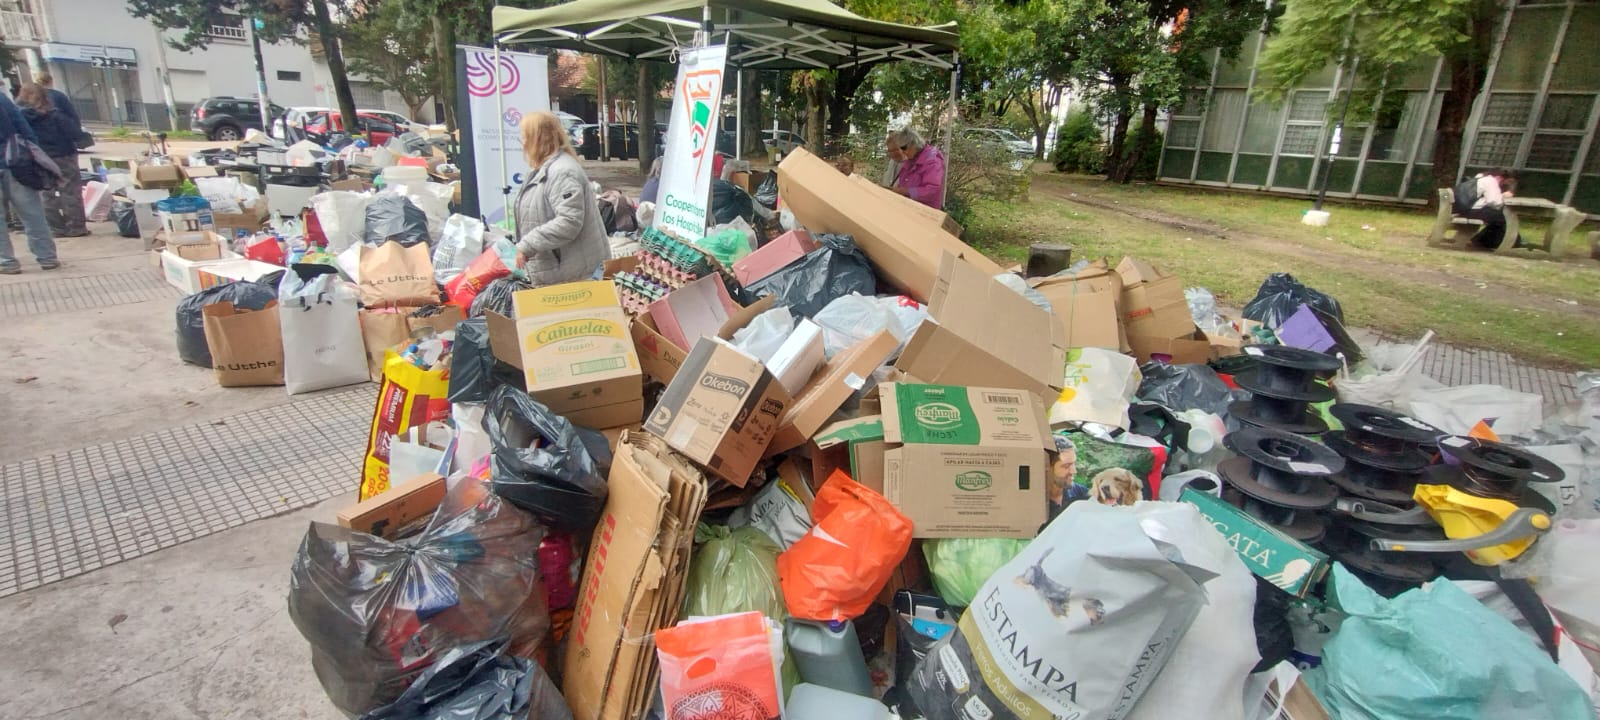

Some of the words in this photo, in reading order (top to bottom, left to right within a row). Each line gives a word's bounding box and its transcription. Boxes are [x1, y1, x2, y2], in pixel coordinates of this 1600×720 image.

[535, 320, 613, 345] Cañuelas
[558, 340, 595, 354] Girasol
[228, 360, 277, 371] Utthe
[702, 375, 747, 397] Okebon
[914, 403, 961, 422] Manfrey
[955, 473, 993, 489] Manfrey
[1197, 502, 1273, 569] GATA
[984, 586, 1079, 704] ESTAMPA
[991, 676, 1032, 717] Adultos
